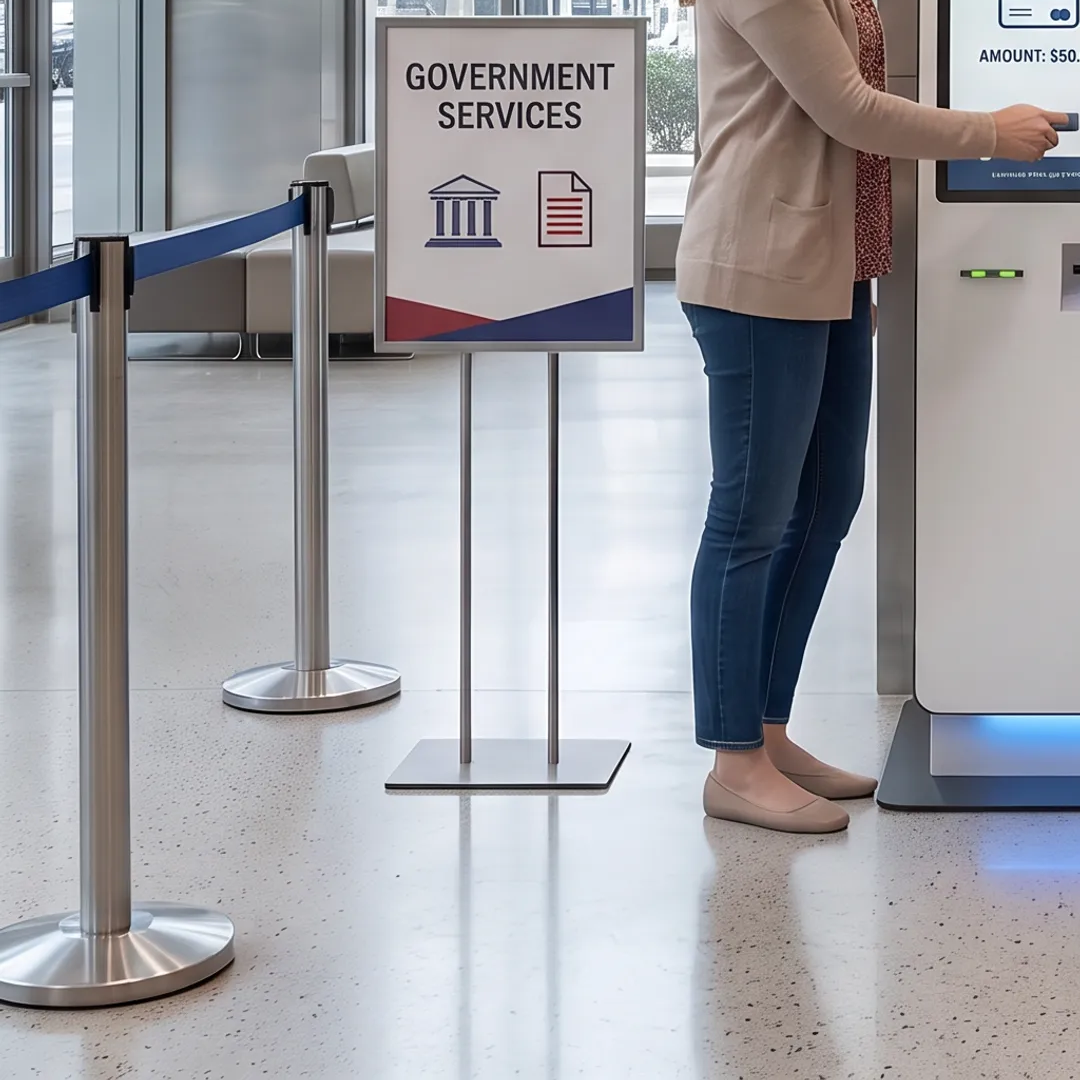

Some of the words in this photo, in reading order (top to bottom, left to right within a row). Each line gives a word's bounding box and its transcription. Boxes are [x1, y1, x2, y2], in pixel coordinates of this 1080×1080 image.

[979, 49, 1046, 63] AMOUNT:
[405, 62, 615, 91] GOVERNMENT
[438, 101, 582, 130] SERVICES
